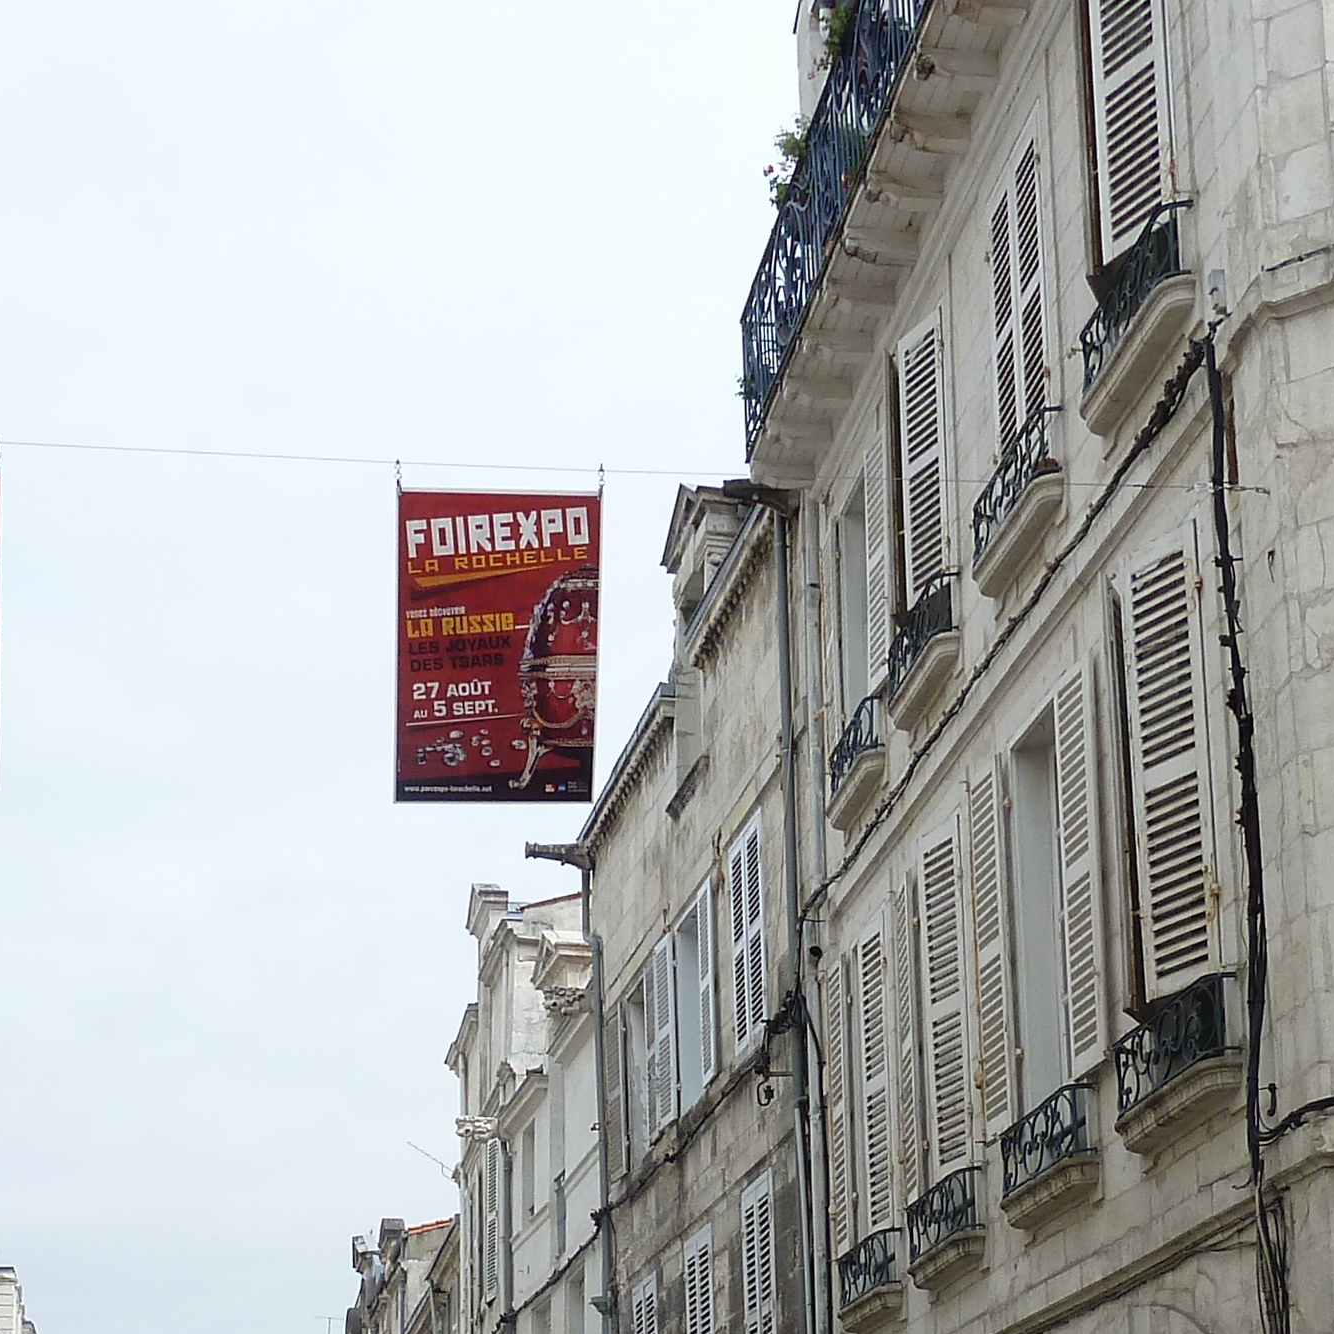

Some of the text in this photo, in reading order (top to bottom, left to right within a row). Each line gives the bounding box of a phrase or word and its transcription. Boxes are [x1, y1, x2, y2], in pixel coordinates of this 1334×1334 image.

[405, 505, 590, 558] FOIREXPO
[407, 546, 588, 575] LA ROCHELLE
[406, 618, 434, 639] LA
[408, 635, 512, 655] LES JOYAUX
[410, 653, 505, 673] DES TSARS
[412, 678, 492, 700] 27 AOÛT
[413, 700, 499, 720] AU 5 SEPT.
